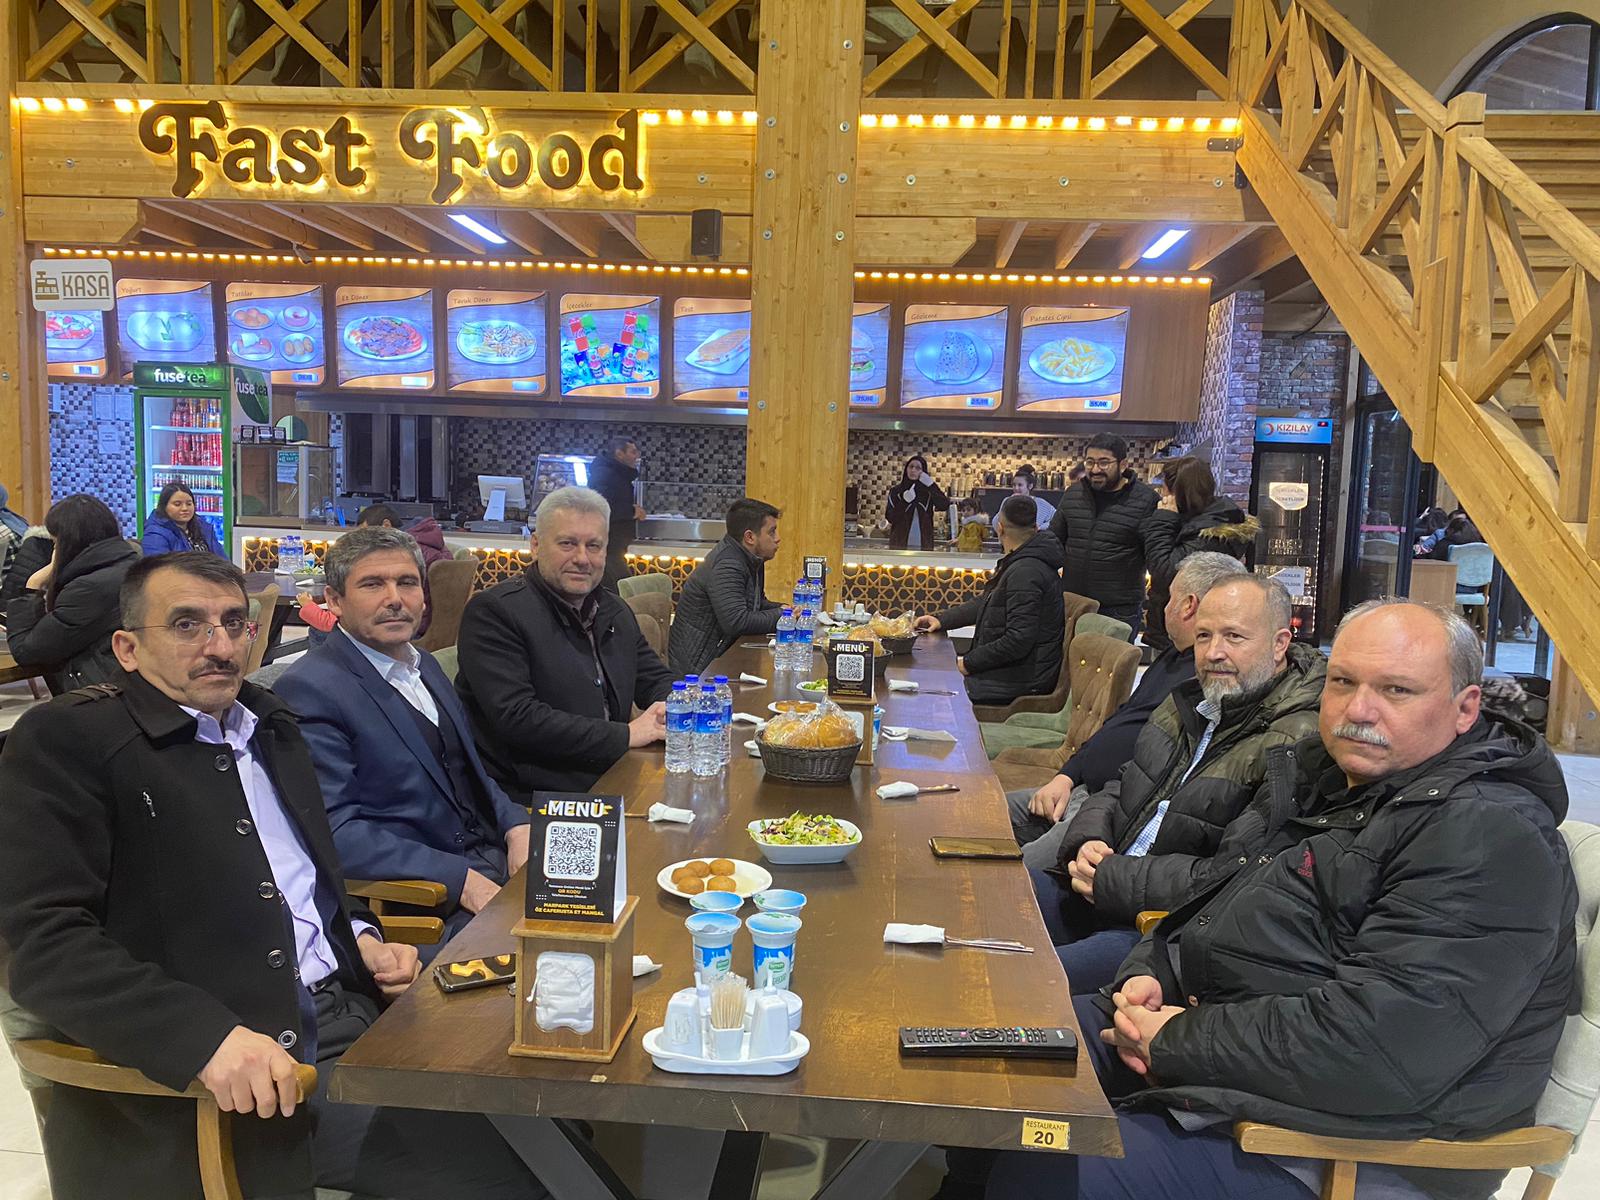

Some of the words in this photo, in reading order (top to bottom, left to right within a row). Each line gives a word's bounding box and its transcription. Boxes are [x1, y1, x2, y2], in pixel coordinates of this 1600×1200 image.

[138, 101, 368, 199] Fast
[399, 106, 645, 205] Food
[63, 275, 110, 297] KASA
[153, 368, 207, 384] fusetea
[234, 378, 269, 397] fusetea
[1276, 423, 1313, 432] KIZILAY
[836, 642, 865, 653] MENÜ
[547, 799, 605, 818] MENÜ
[1026, 1121, 1065, 1131] RESTAURANT
[1034, 1131, 1054, 1145] 20
